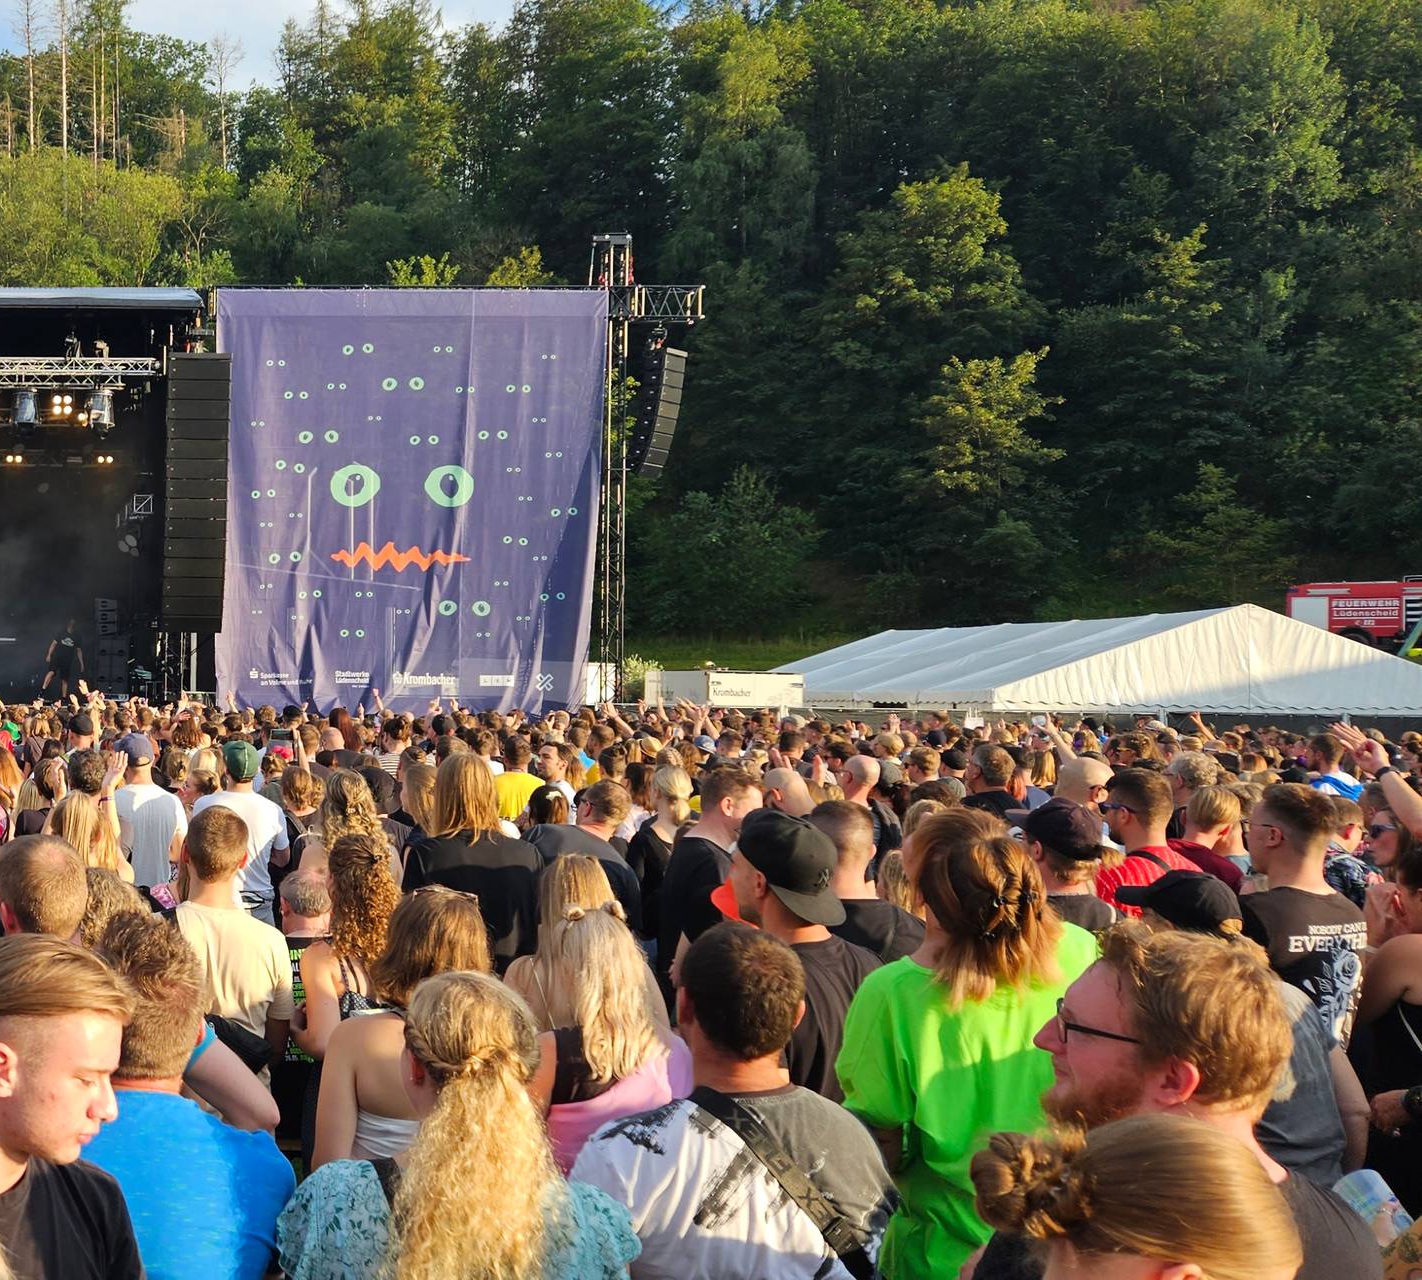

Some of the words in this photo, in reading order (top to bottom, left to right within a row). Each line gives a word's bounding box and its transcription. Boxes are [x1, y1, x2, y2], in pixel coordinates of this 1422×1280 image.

[1331, 599, 1400, 607] FEUERWEHR
[1333, 609, 1399, 617] Lüdenscheid
[335, 670, 370, 678] Stadtwerke
[403, 672, 456, 686] Krombacher
[712, 687, 751, 697] Krombacher
[1308, 924, 1343, 935] NOBODY
